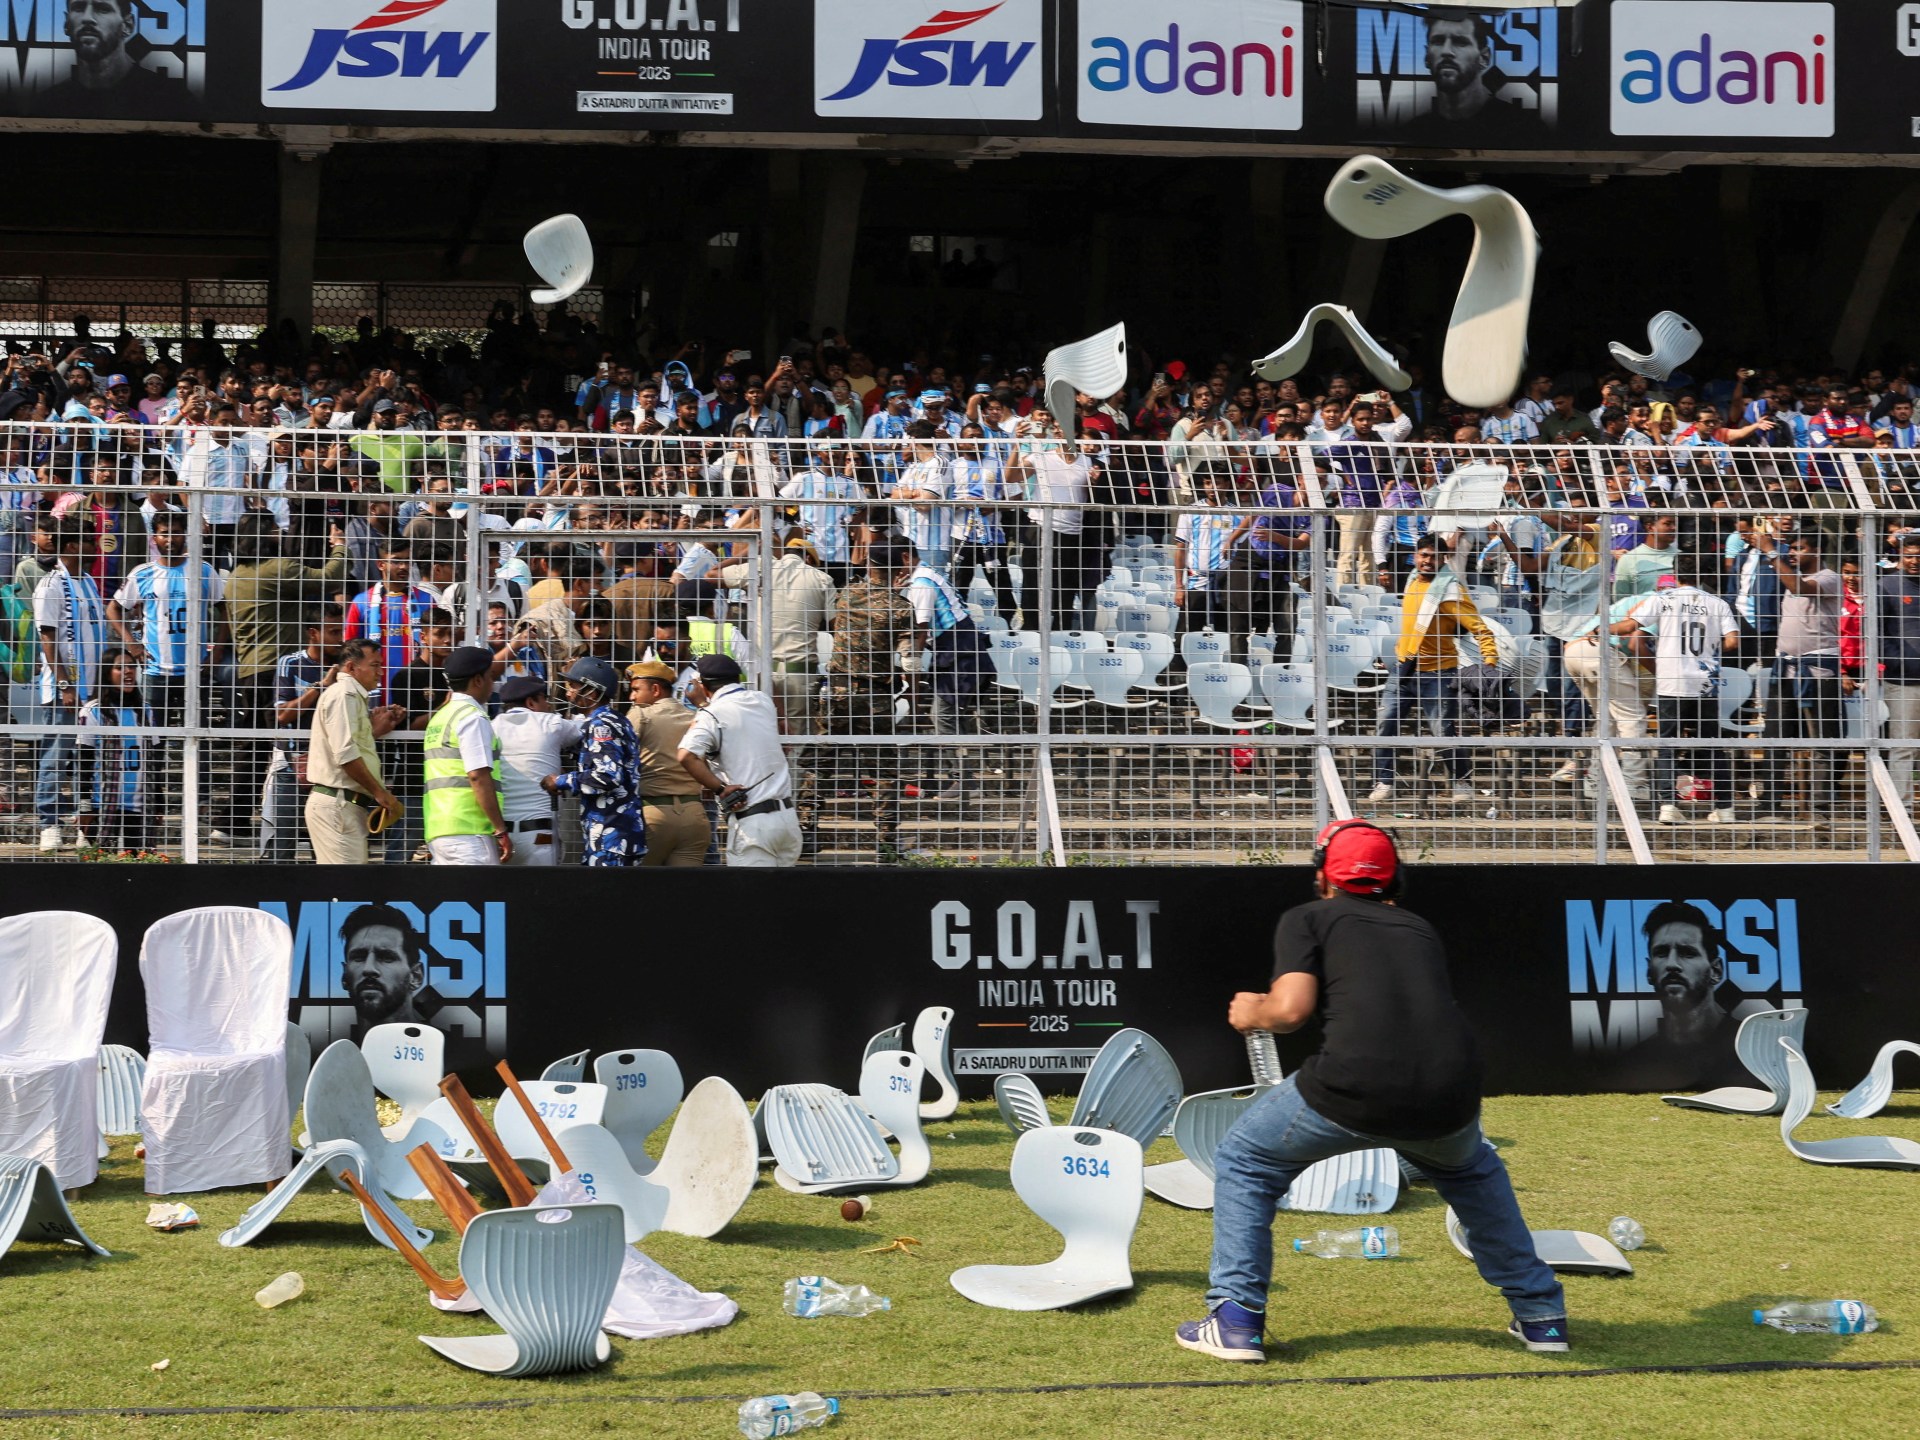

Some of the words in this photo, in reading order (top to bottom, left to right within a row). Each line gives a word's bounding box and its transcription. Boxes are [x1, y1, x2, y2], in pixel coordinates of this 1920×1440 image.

[0, 0, 206, 46] MSI
[598, 38, 651, 60] INDIA
[659, 38, 711, 61] TOUR
[1357, 8, 1558, 77] MSI
[267, 29, 491, 91] JSW
[638, 66, 671, 80] 2025
[820, 39, 1036, 100] JSW
[1088, 23, 1293, 97] adani
[1621, 33, 1825, 104] adani
[581, 99, 589, 108] A
[591, 98, 636, 109] SATADRU
[638, 98, 669, 110] DUTTA
[1681, 620, 1706, 657] 10
[1099, 658, 1124, 667] 3832
[258, 901, 506, 998] MSI
[931, 900, 1160, 970] G.O.A.T
[1564, 898, 1801, 993] MSI
[978, 979, 1045, 1008] INDIA
[1052, 979, 1117, 1008] TOUR
[1029, 1015, 1069, 1032] 2025
[394, 1046, 424, 1061] 3796
[959, 1057, 969, 1070] A
[971, 1056, 1026, 1070] SATADRU
[1028, 1056, 1068, 1070] DUTTA
[616, 1072, 647, 1091] 3799
[537, 1101, 577, 1119] 3792
[1062, 1156, 1110, 1179] 3634
